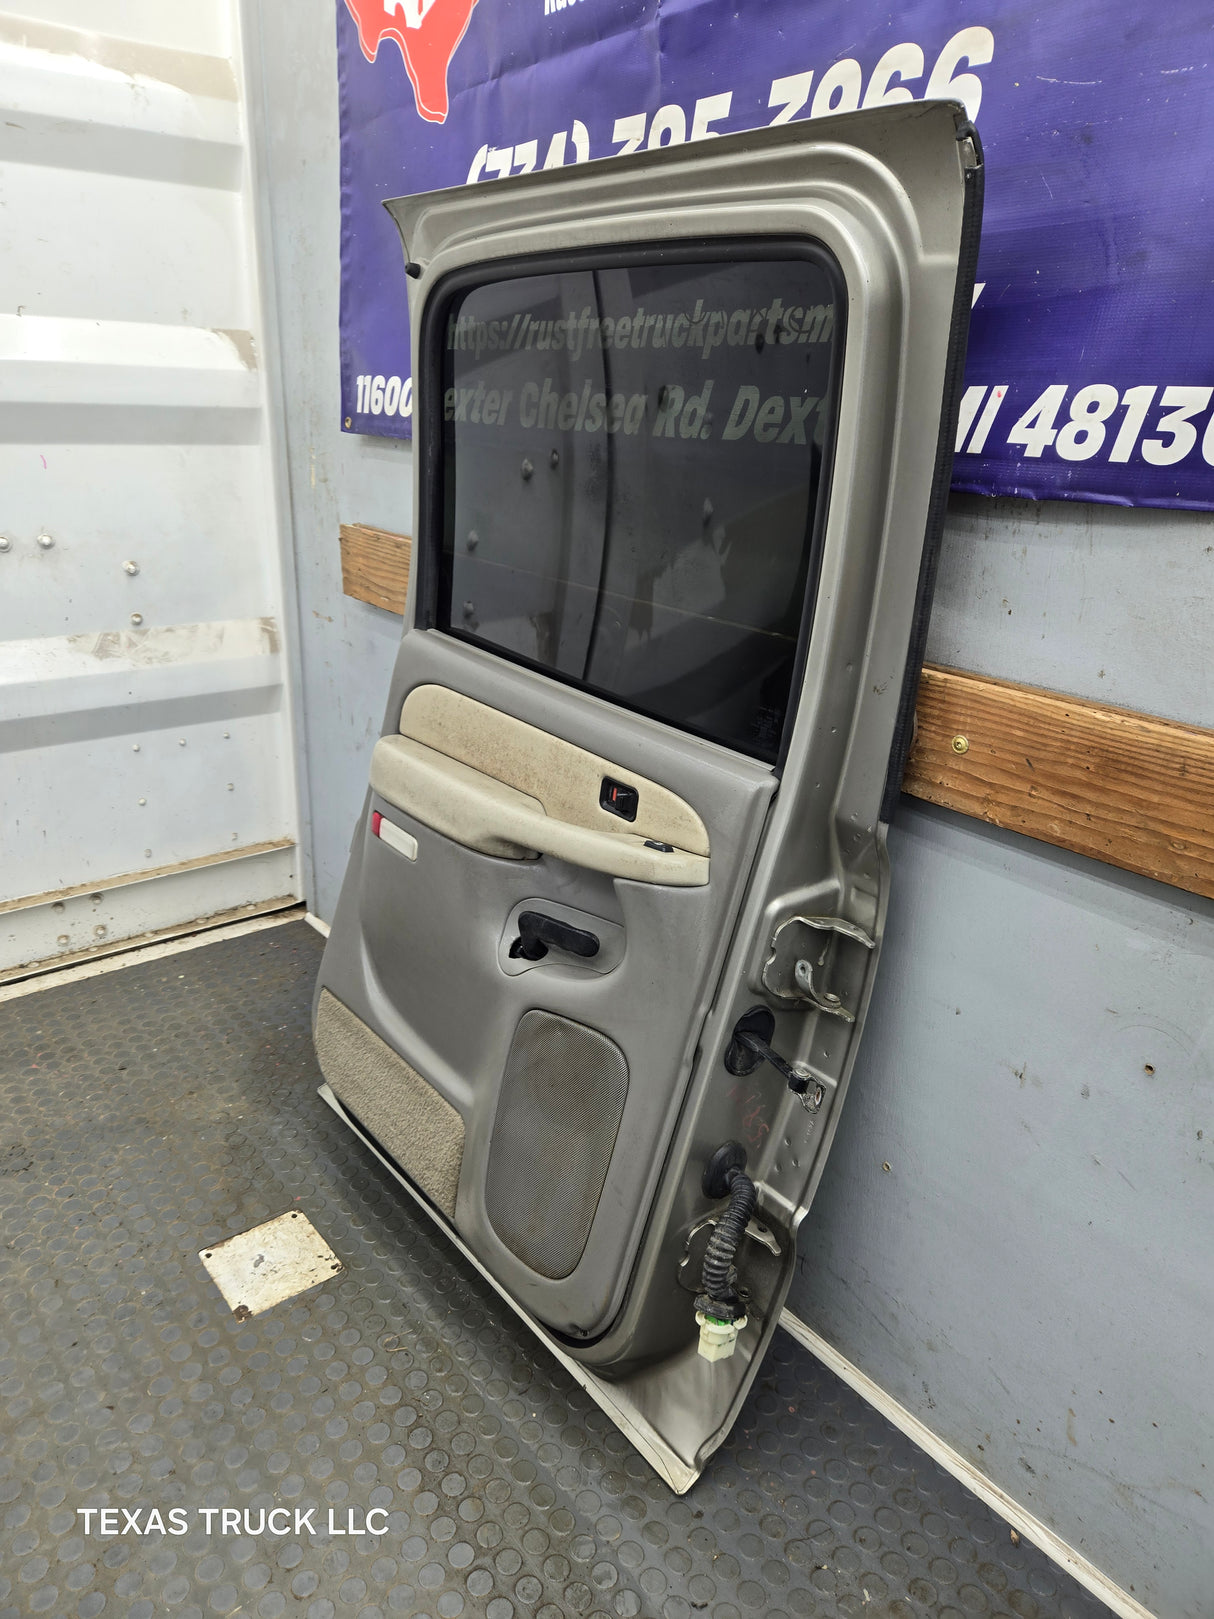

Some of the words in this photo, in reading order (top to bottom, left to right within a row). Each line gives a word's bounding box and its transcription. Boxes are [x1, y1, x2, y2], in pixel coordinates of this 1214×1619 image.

[356, 375, 413, 418] 11600
[519, 377, 649, 436] Chelsea
[652, 379, 715, 440] Rd.
[1006, 383, 1214, 467] 4813
